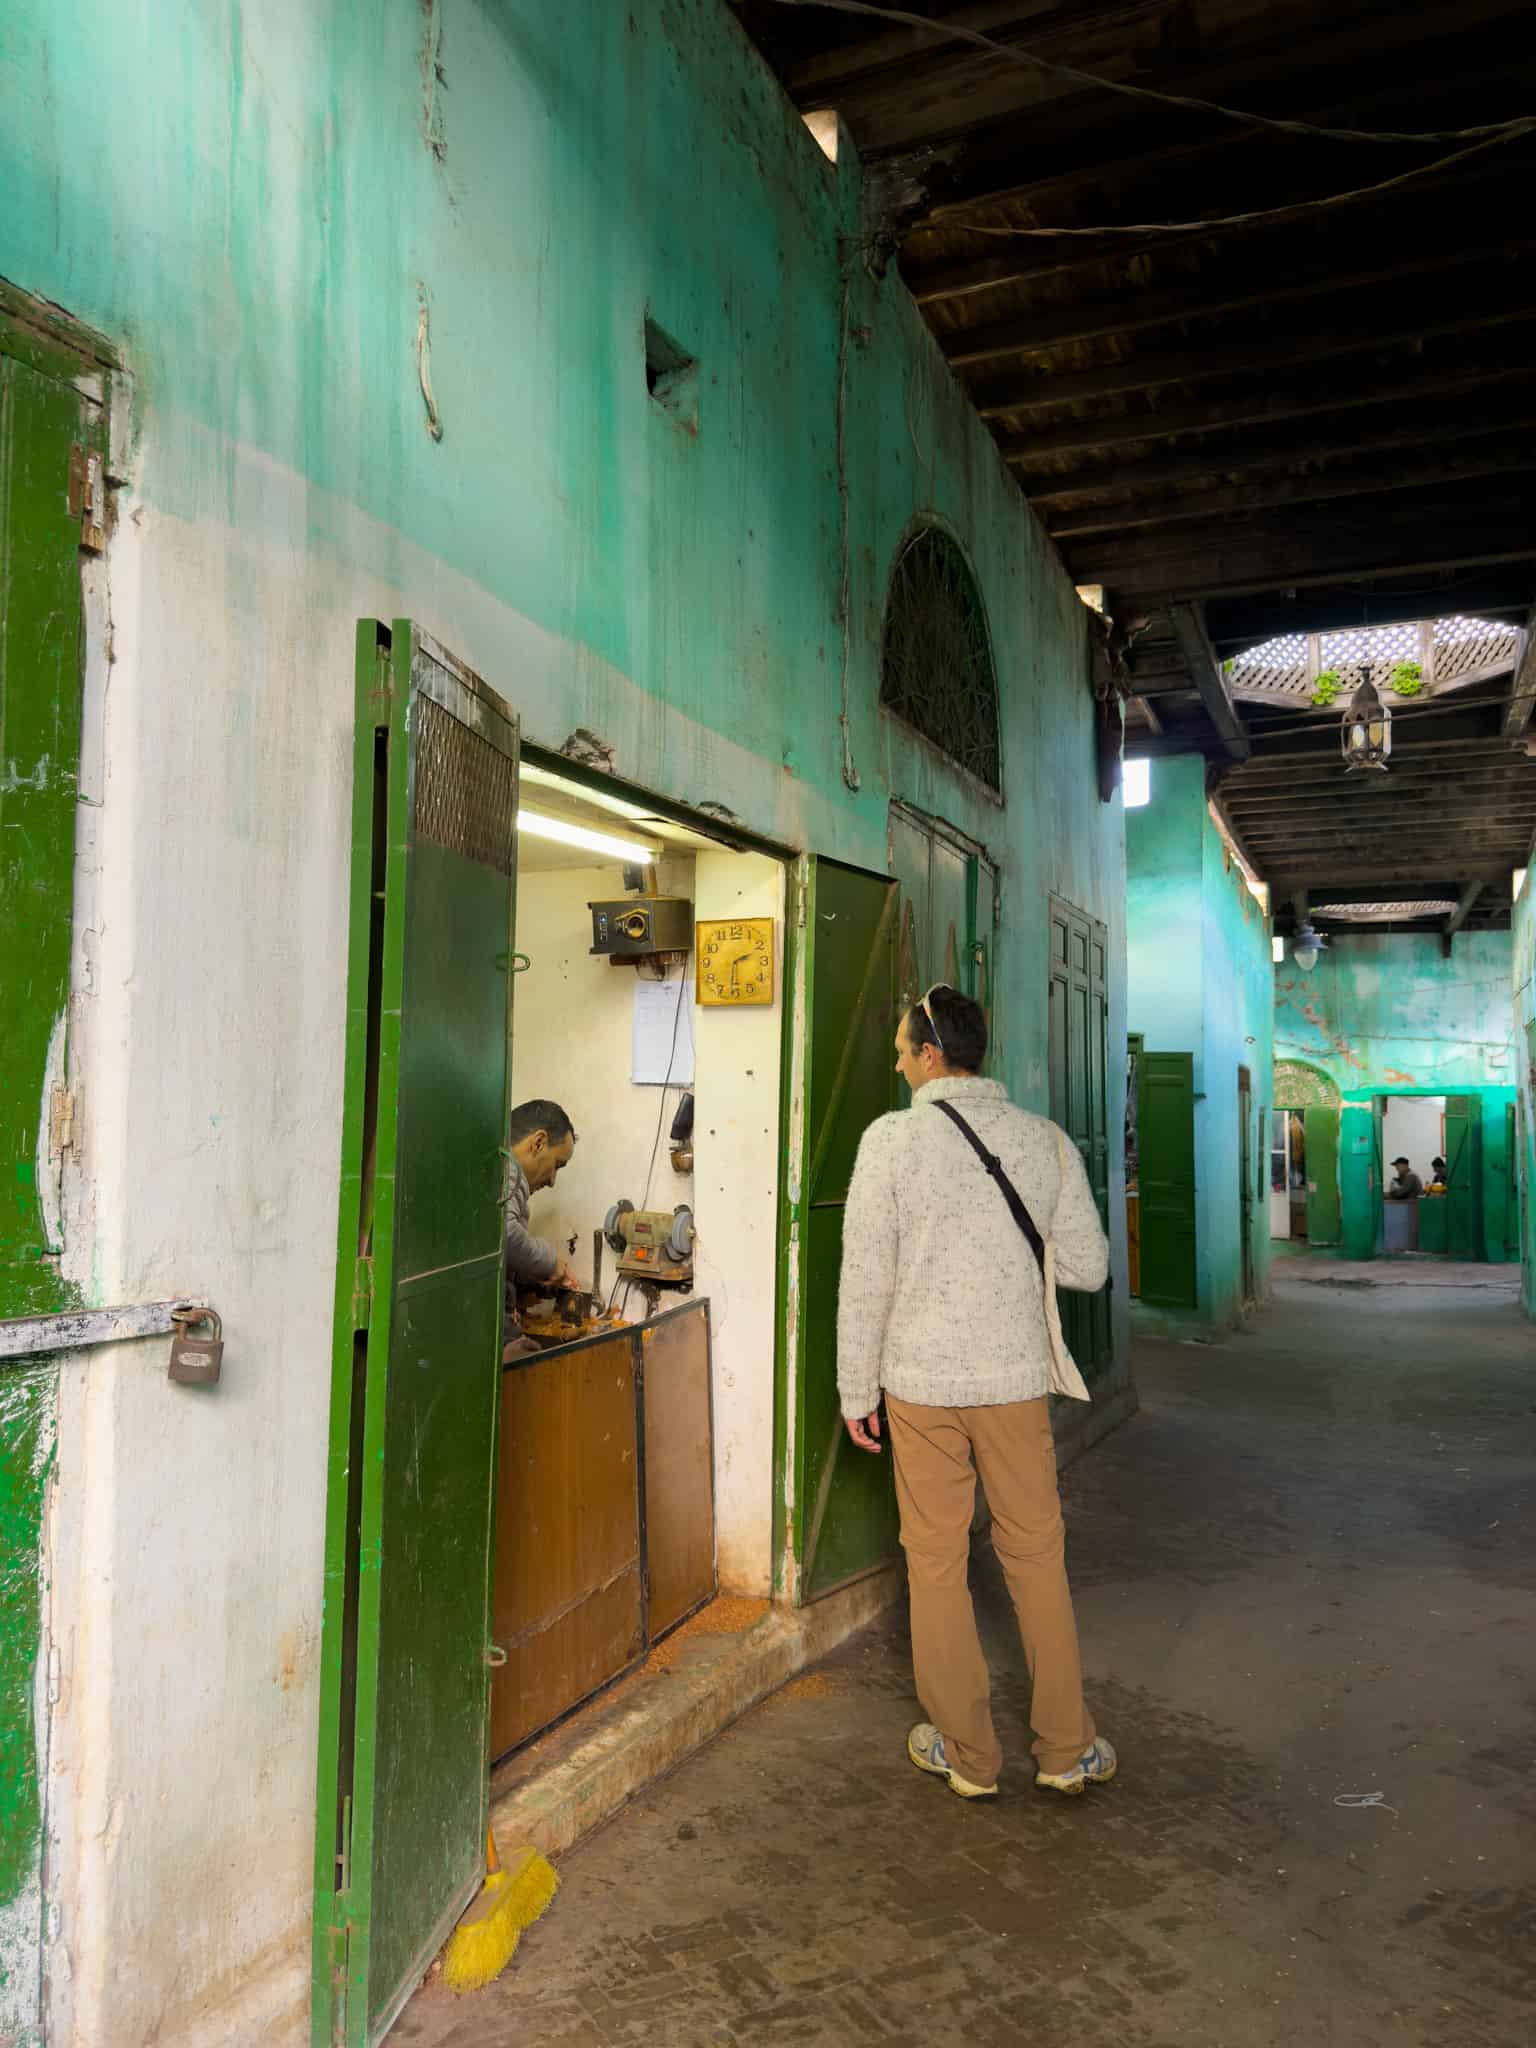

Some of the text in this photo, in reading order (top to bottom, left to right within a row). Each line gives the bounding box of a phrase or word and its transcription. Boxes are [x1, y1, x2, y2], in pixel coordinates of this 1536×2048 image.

[706, 943, 719, 953] 10
[754, 940, 765, 950] 2
[702, 957, 711, 968] 9
[760, 955, 769, 966] 3
[706, 973, 715, 984] 8
[756, 972, 765, 984] 4
[716, 984, 724, 996] 7
[746, 983, 754, 993] 5
